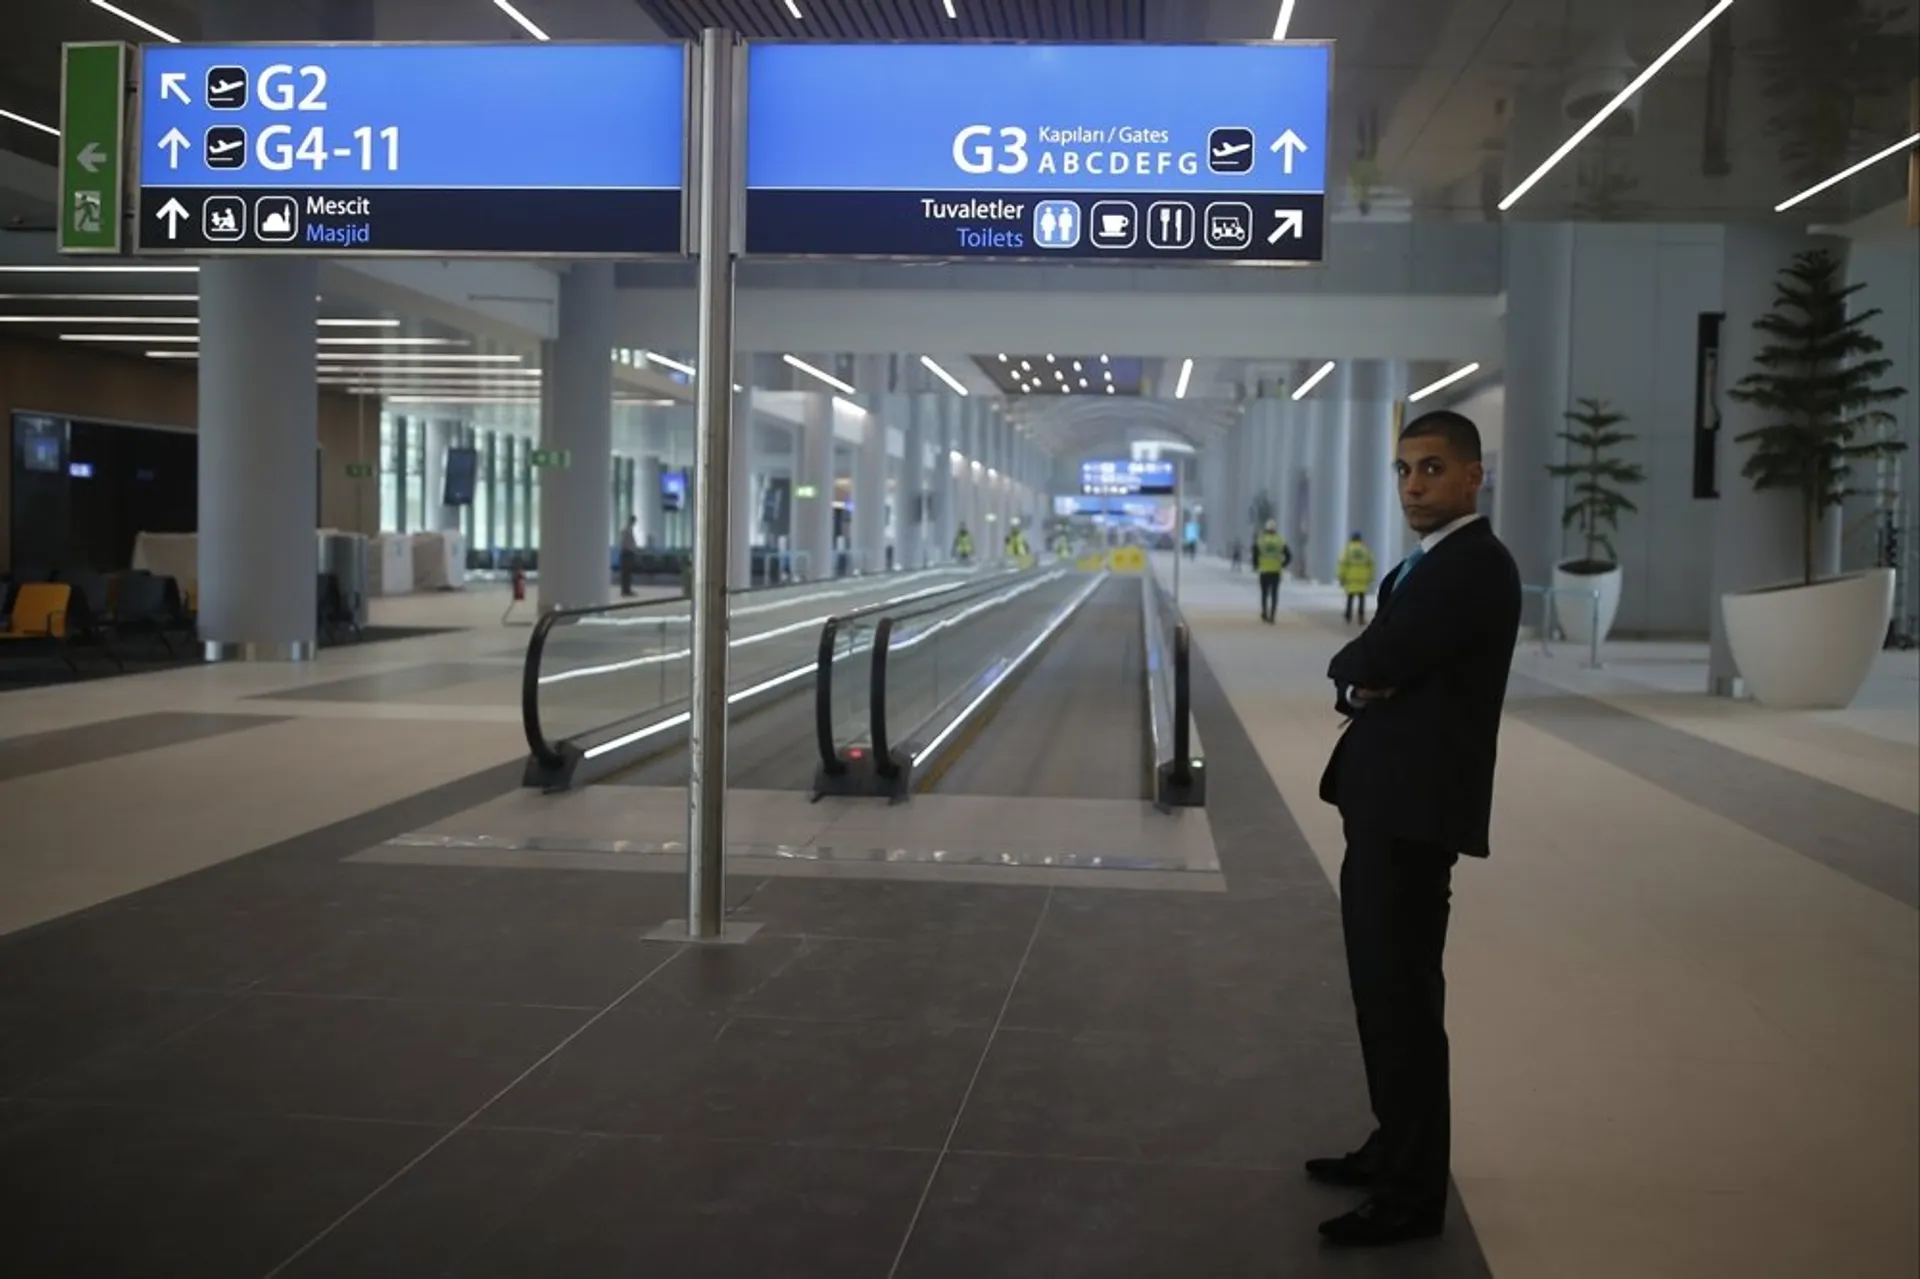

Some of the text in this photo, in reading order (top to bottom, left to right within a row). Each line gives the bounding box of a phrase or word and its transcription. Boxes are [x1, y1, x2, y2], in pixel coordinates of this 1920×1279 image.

[257, 64, 328, 110] G2
[256, 124, 399, 171] G4-11
[1038, 126, 1105, 147] Kapıları
[1118, 126, 1169, 144] Gates
[952, 125, 1028, 174] G3
[306, 195, 370, 215] Mescit
[920, 198, 1024, 219] Tuvaletler
[306, 223, 370, 247] Masjid
[957, 228, 1024, 248] Toilets
